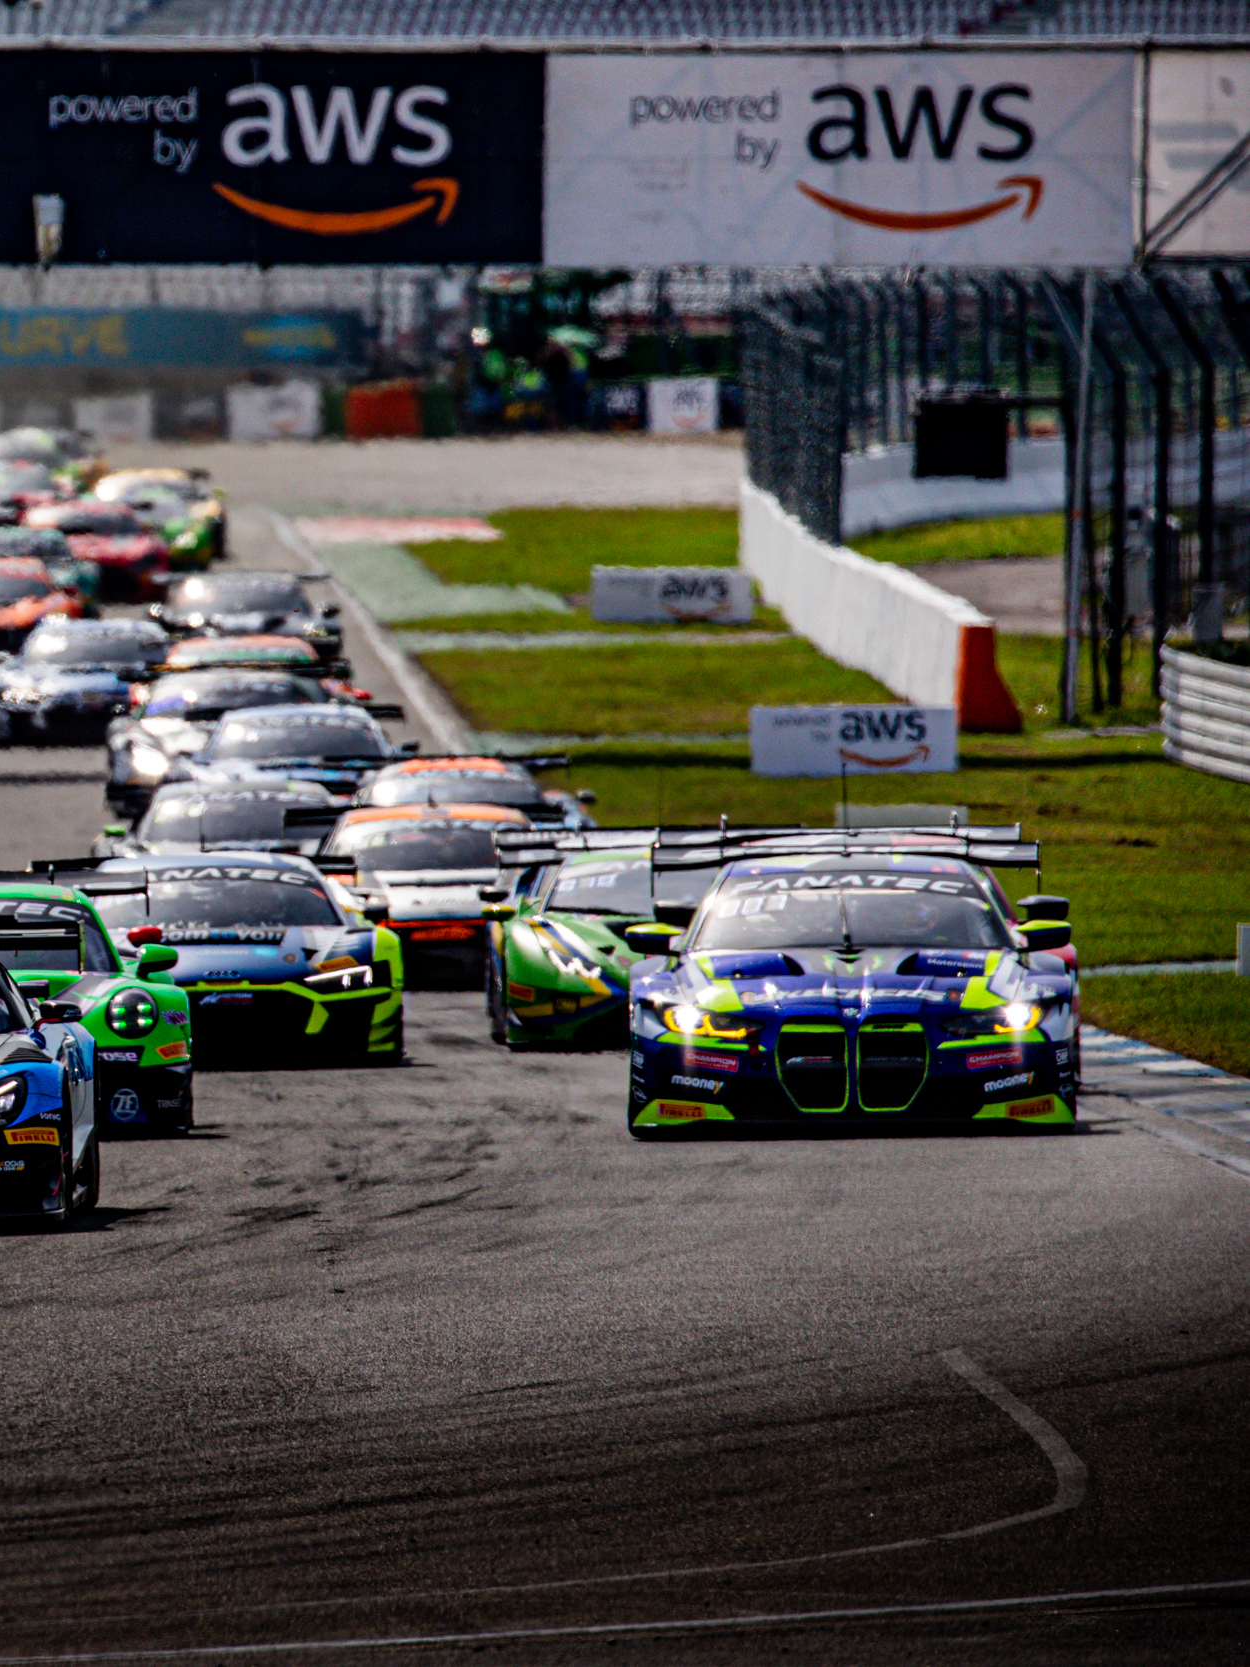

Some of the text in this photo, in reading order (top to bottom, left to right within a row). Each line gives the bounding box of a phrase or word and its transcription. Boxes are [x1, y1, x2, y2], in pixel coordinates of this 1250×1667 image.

[48, 88, 197, 128] powered
[630, 92, 779, 129] powered
[221, 84, 452, 168] aws
[807, 84, 1036, 163] aws
[153, 130, 198, 172] by
[735, 131, 779, 170] by
[839, 710, 927, 743] aws
[148, 867, 311, 885] NATEC
[731, 875, 967, 895] FANATEC
[687, 1052, 736, 1066] CHAMPION
[969, 1051, 1019, 1064] CHAMPION
[671, 1074, 724, 1094] mooney
[984, 1071, 1035, 1092] mooney
[113, 1094, 138, 1114] ZF
[10, 1129, 56, 1143] PIRELLI
